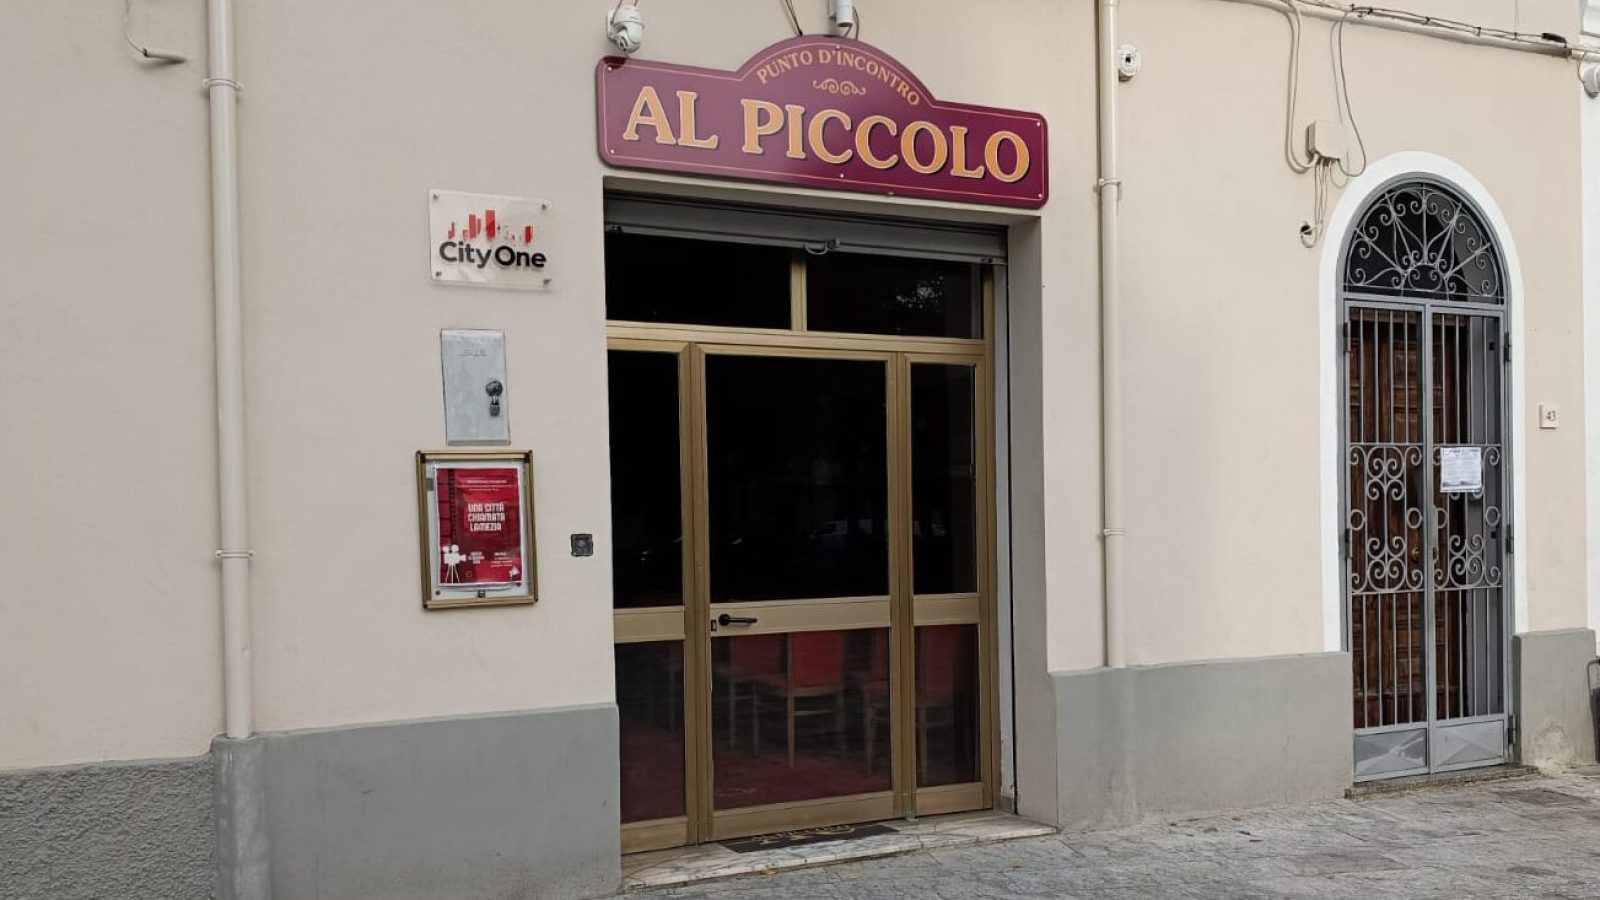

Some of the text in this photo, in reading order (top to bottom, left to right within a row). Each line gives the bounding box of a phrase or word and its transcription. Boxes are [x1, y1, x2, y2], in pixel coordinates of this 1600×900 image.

[756, 49, 920, 105] PUNTO D'INCONTRO
[622, 86, 1030, 183] AL PICCOLO
[468, 503, 483, 512] UNA
[468, 513, 505, 522] CHIAMATA
